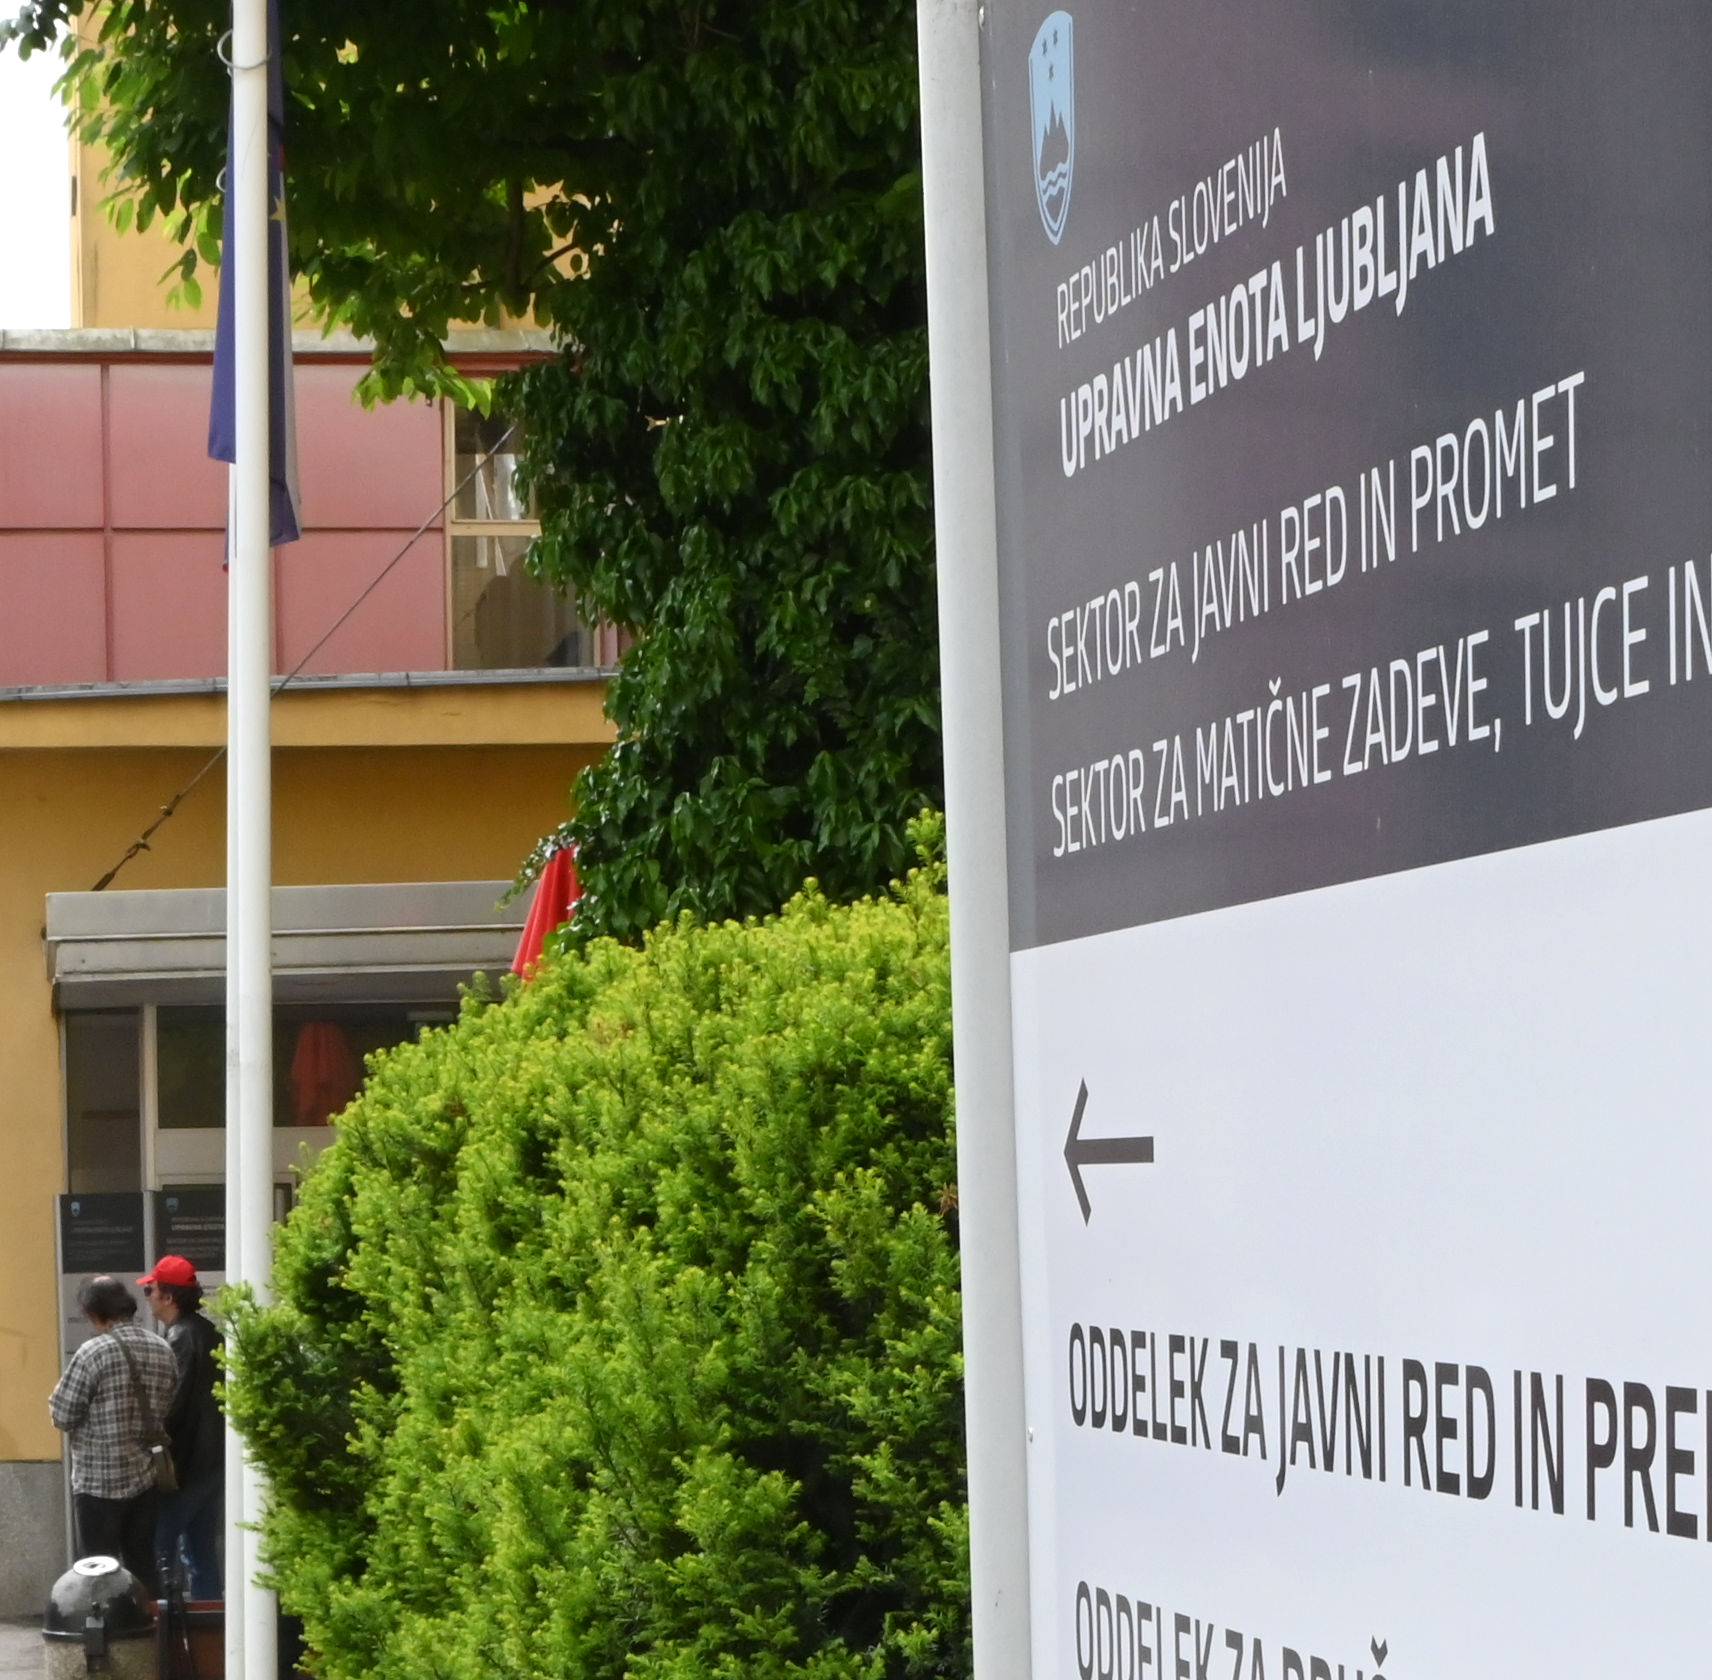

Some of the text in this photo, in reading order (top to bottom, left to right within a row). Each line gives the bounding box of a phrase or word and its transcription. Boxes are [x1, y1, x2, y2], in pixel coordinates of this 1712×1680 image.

[1057, 127, 1286, 349] REPUBLIKA SLOVENIJA
[1061, 132, 1494, 477] UPRAVNA ENOTA LJUBLJANA
[1048, 371, 1584, 700] SEKTOR ZA JAVNI RED IN PROMET
[1052, 749, 1146, 857] SEKTOR
[1153, 735, 1188, 828] ZA
[1196, 677, 1331, 816] MATIČNE
[1342, 630, 1500, 775] ZADEVE,
[1515, 576, 1649, 740] TUJCE
[1070, 1323, 1211, 1449] ODDELEK
[1221, 1340, 1266, 1460] ZA
[1276, 1346, 1385, 1496] JAVNI
[1403, 1359, 1495, 1499] RED
[1514, 1370, 1564, 1515] IN
